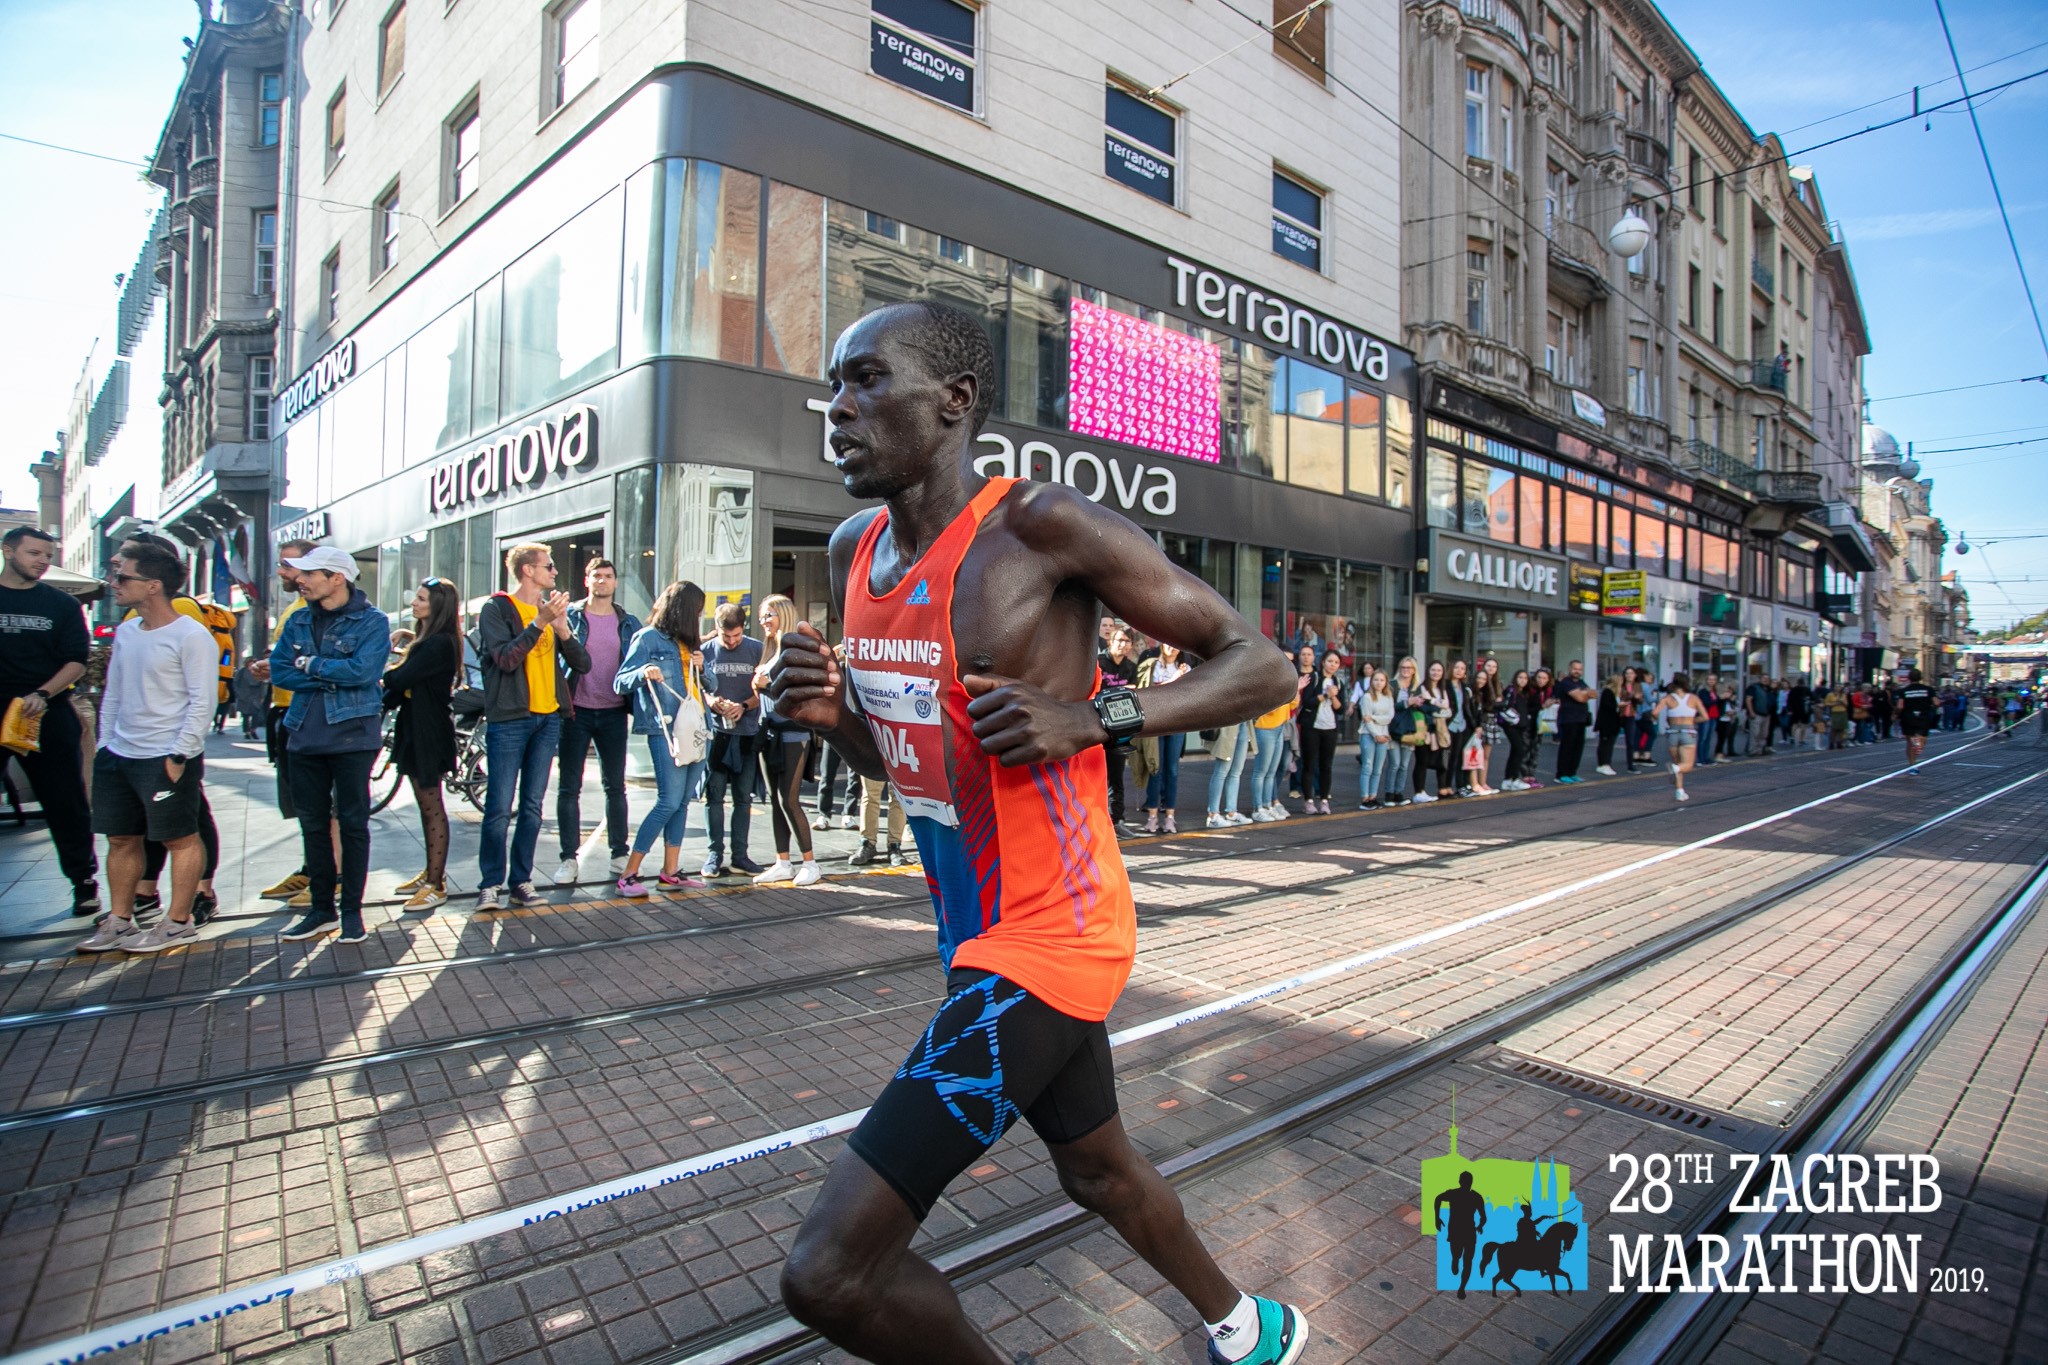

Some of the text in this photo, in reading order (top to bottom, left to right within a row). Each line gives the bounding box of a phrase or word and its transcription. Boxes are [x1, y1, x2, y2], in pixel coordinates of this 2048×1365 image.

[877, 30, 965, 82] Terranova
[902, 57, 945, 82] FROM ITALY
[1106, 139, 1170, 179] Terranova
[1167, 255, 1389, 382] Terranova
[280, 336, 353, 423] Terranova
[422, 402, 591, 514] Terranova
[806, 397, 1178, 517] Tanova
[1447, 547, 1559, 597] CALLIOPE
[858, 638, 943, 667] RUNNING
[914, 690, 932, 698] SPORT
